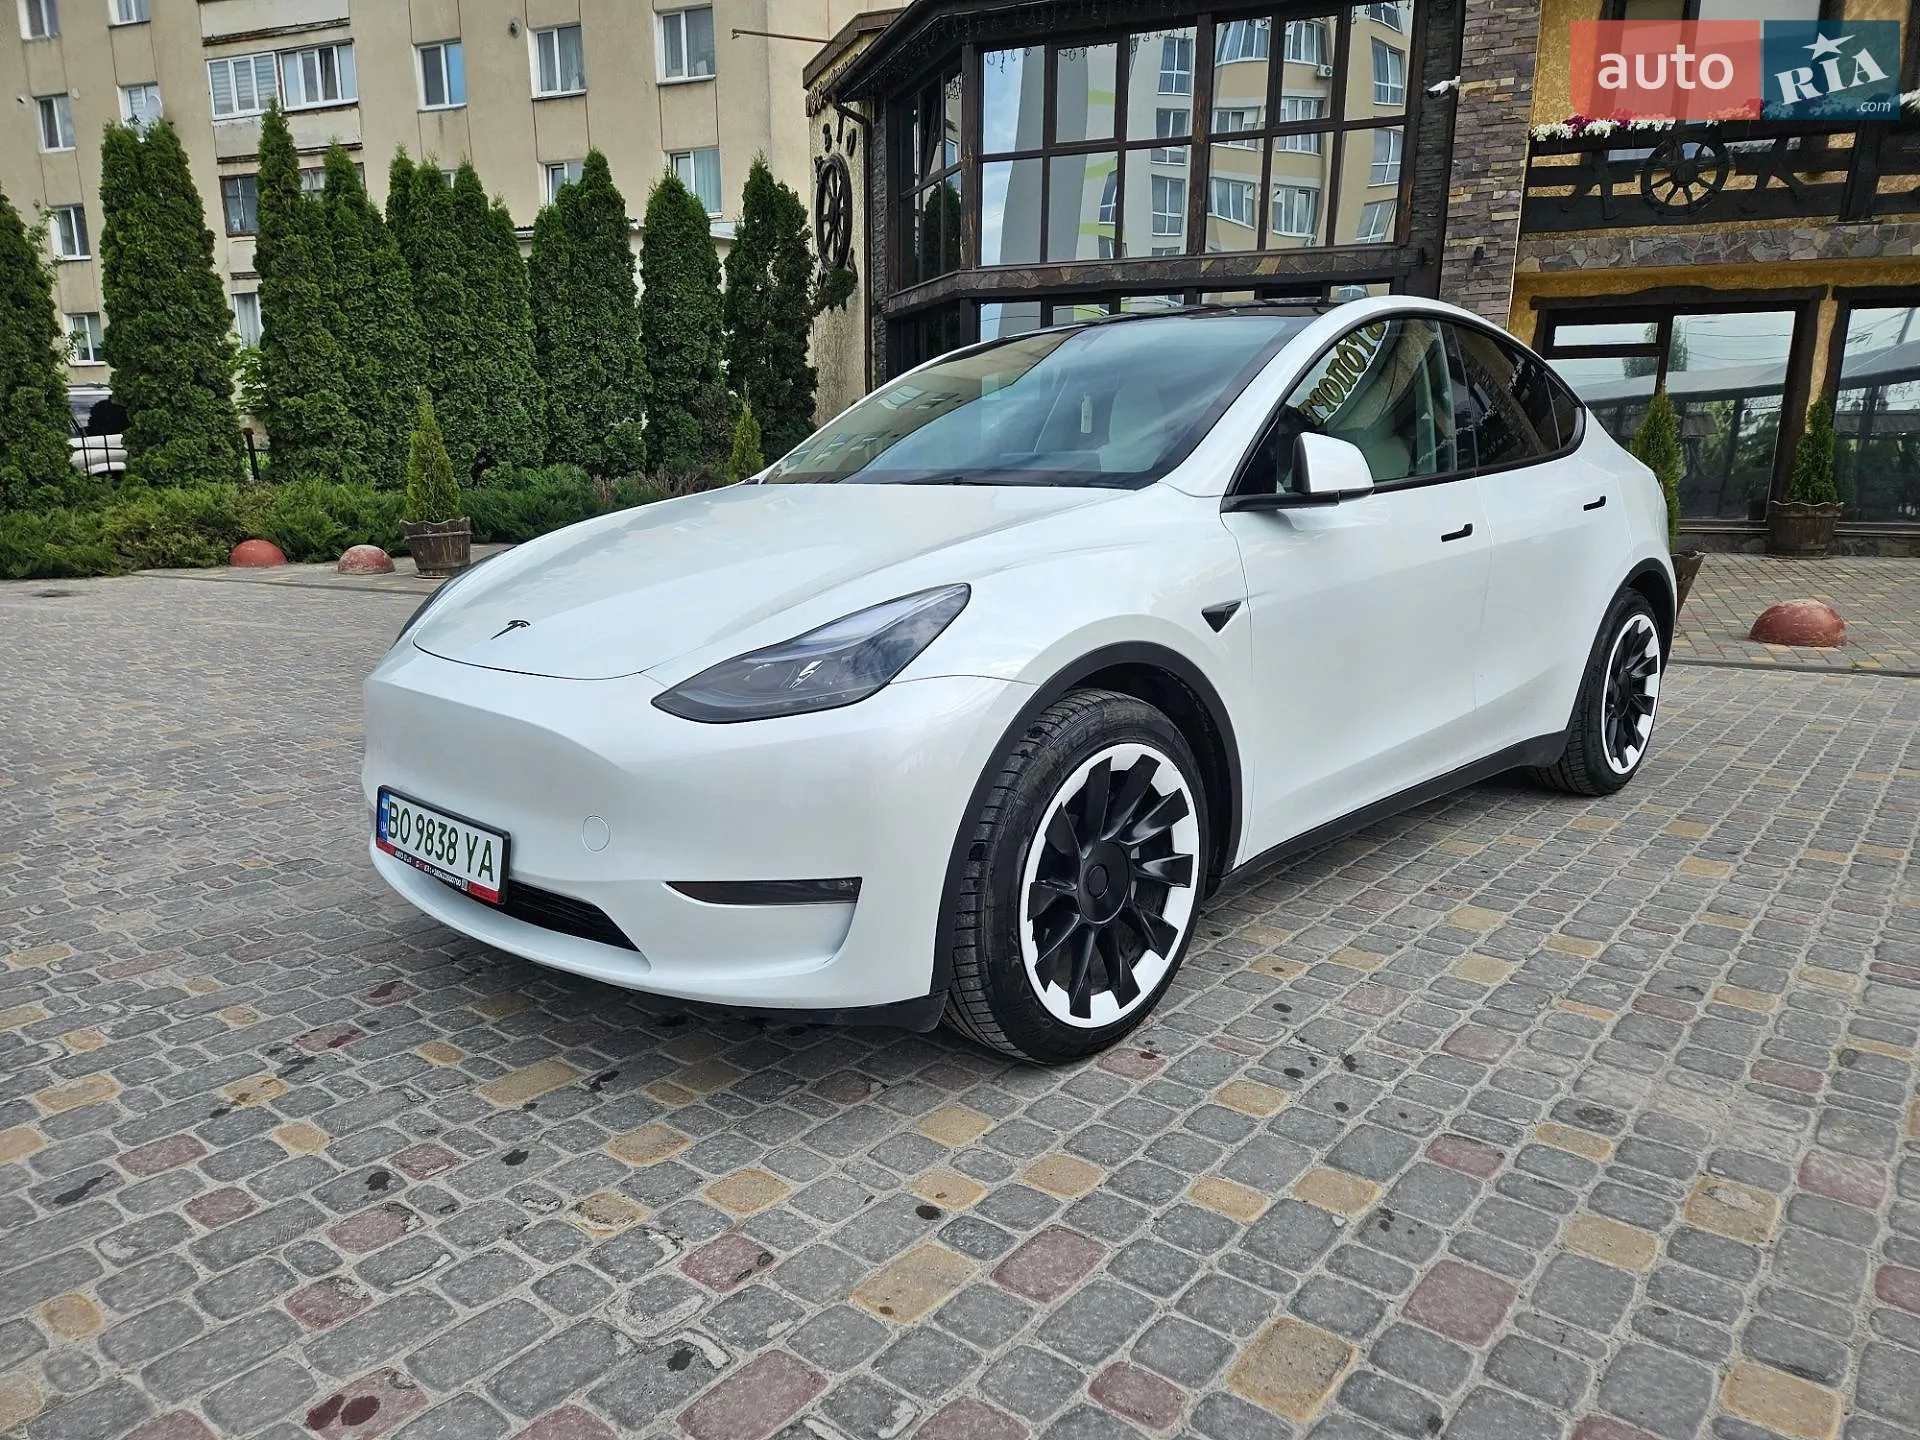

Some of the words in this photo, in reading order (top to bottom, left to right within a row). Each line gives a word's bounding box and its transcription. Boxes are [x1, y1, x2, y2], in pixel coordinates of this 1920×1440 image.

[387, 801, 411, 845] BO
[414, 813, 459, 866] 9838
[465, 832, 494, 882] YA
